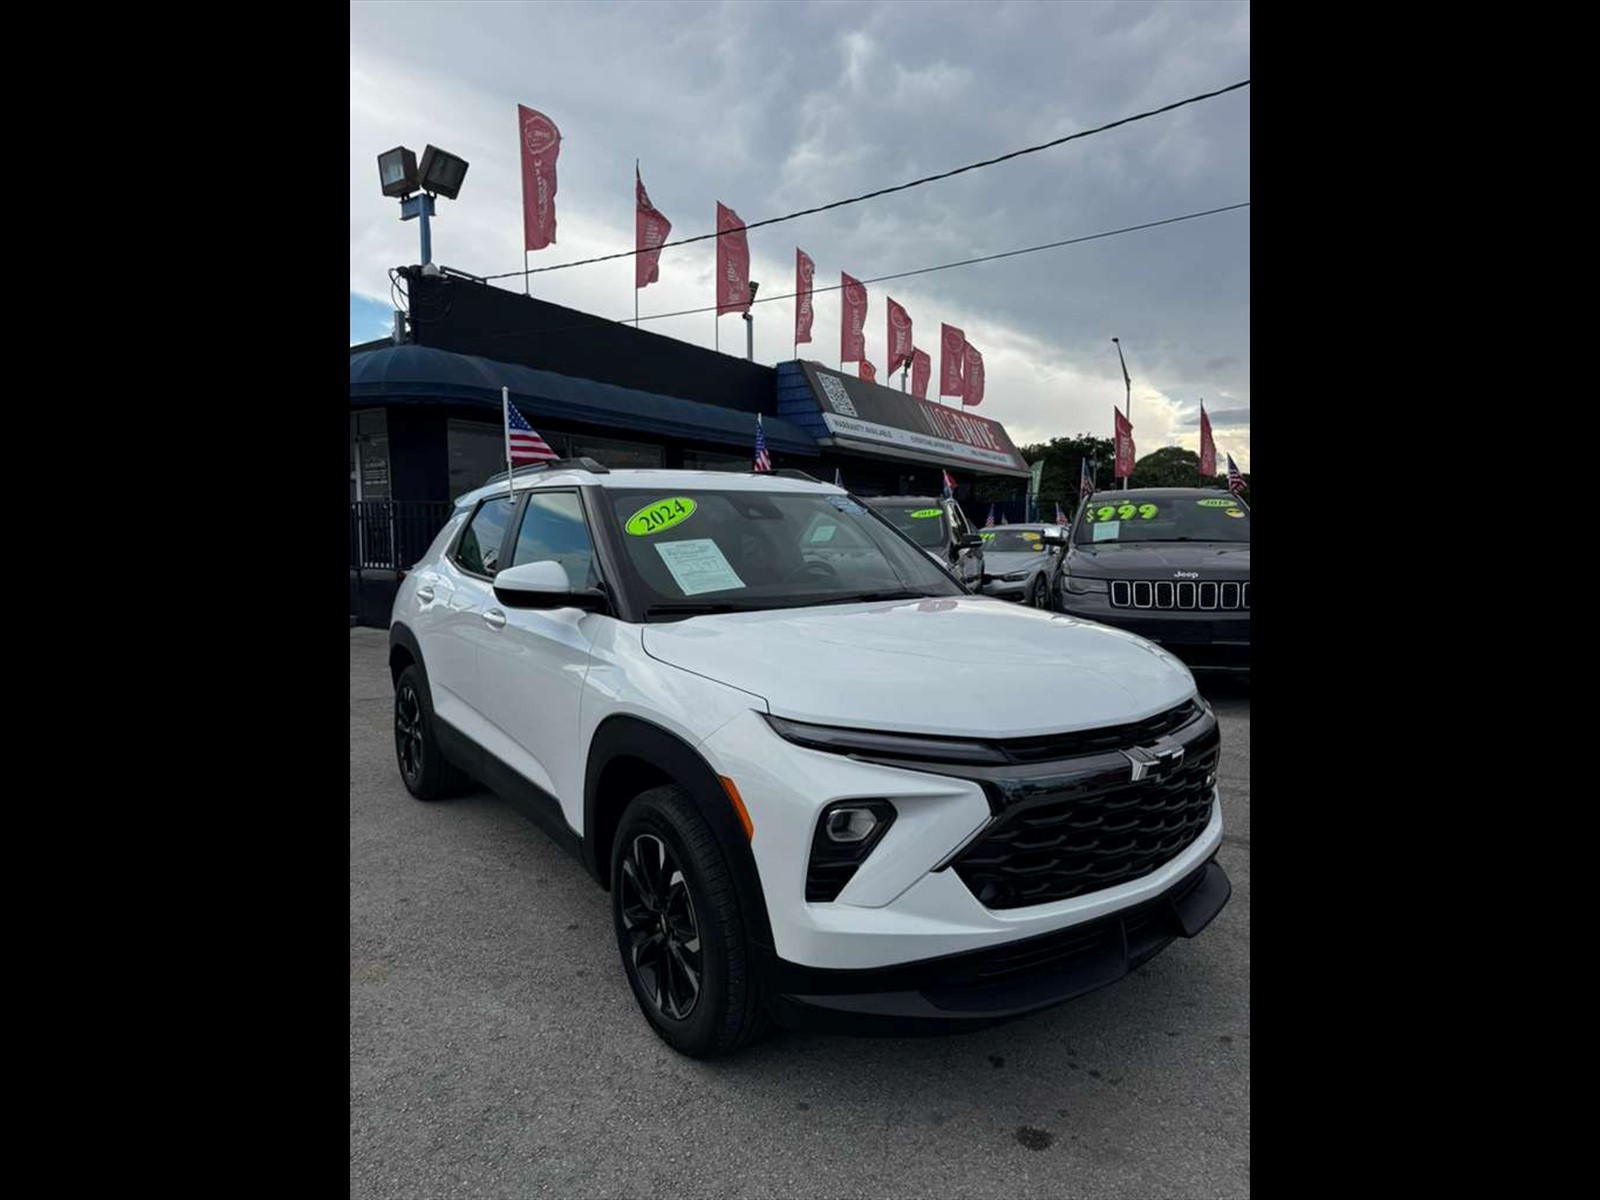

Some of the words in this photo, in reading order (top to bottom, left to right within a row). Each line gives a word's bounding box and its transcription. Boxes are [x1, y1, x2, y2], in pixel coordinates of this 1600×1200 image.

[638, 499, 686, 532] 2024
[1086, 503, 1159, 524] $999
[1173, 571, 1200, 579] Jeep
